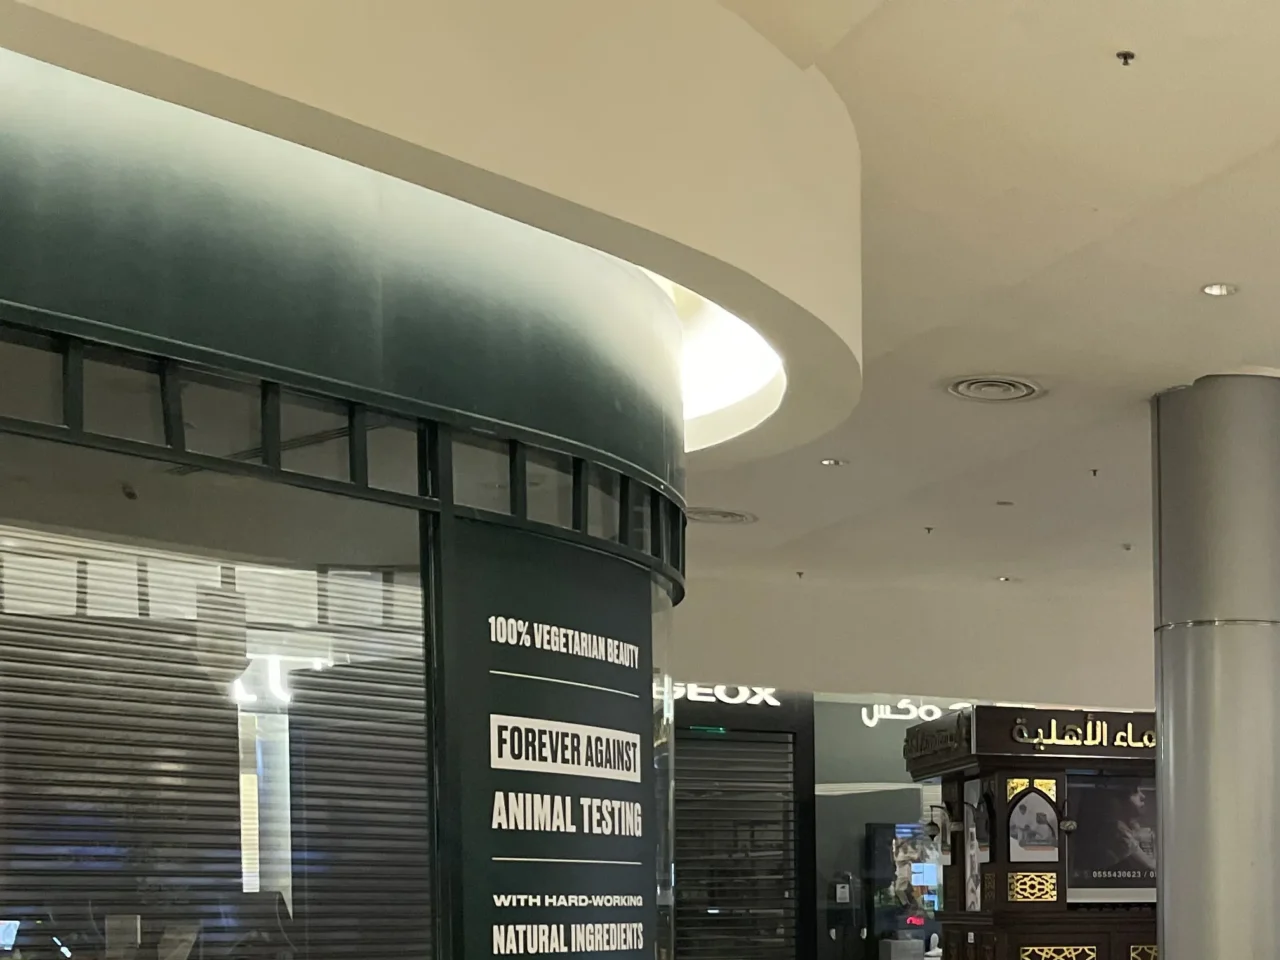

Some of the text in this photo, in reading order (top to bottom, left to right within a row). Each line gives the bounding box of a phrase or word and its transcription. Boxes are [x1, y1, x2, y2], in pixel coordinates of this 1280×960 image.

[488, 616, 639, 669] 100% VEGETARIAN BEAUTY
[497, 725, 638, 773] FOREVER AGAINST
[1012, 713, 1108, 751] الأهلية
[492, 791, 642, 837] ANIMAL TESTING
[493, 894, 643, 907] WITH HARD-WORKING
[492, 922, 644, 955] NATURAL INGREDIENTS
